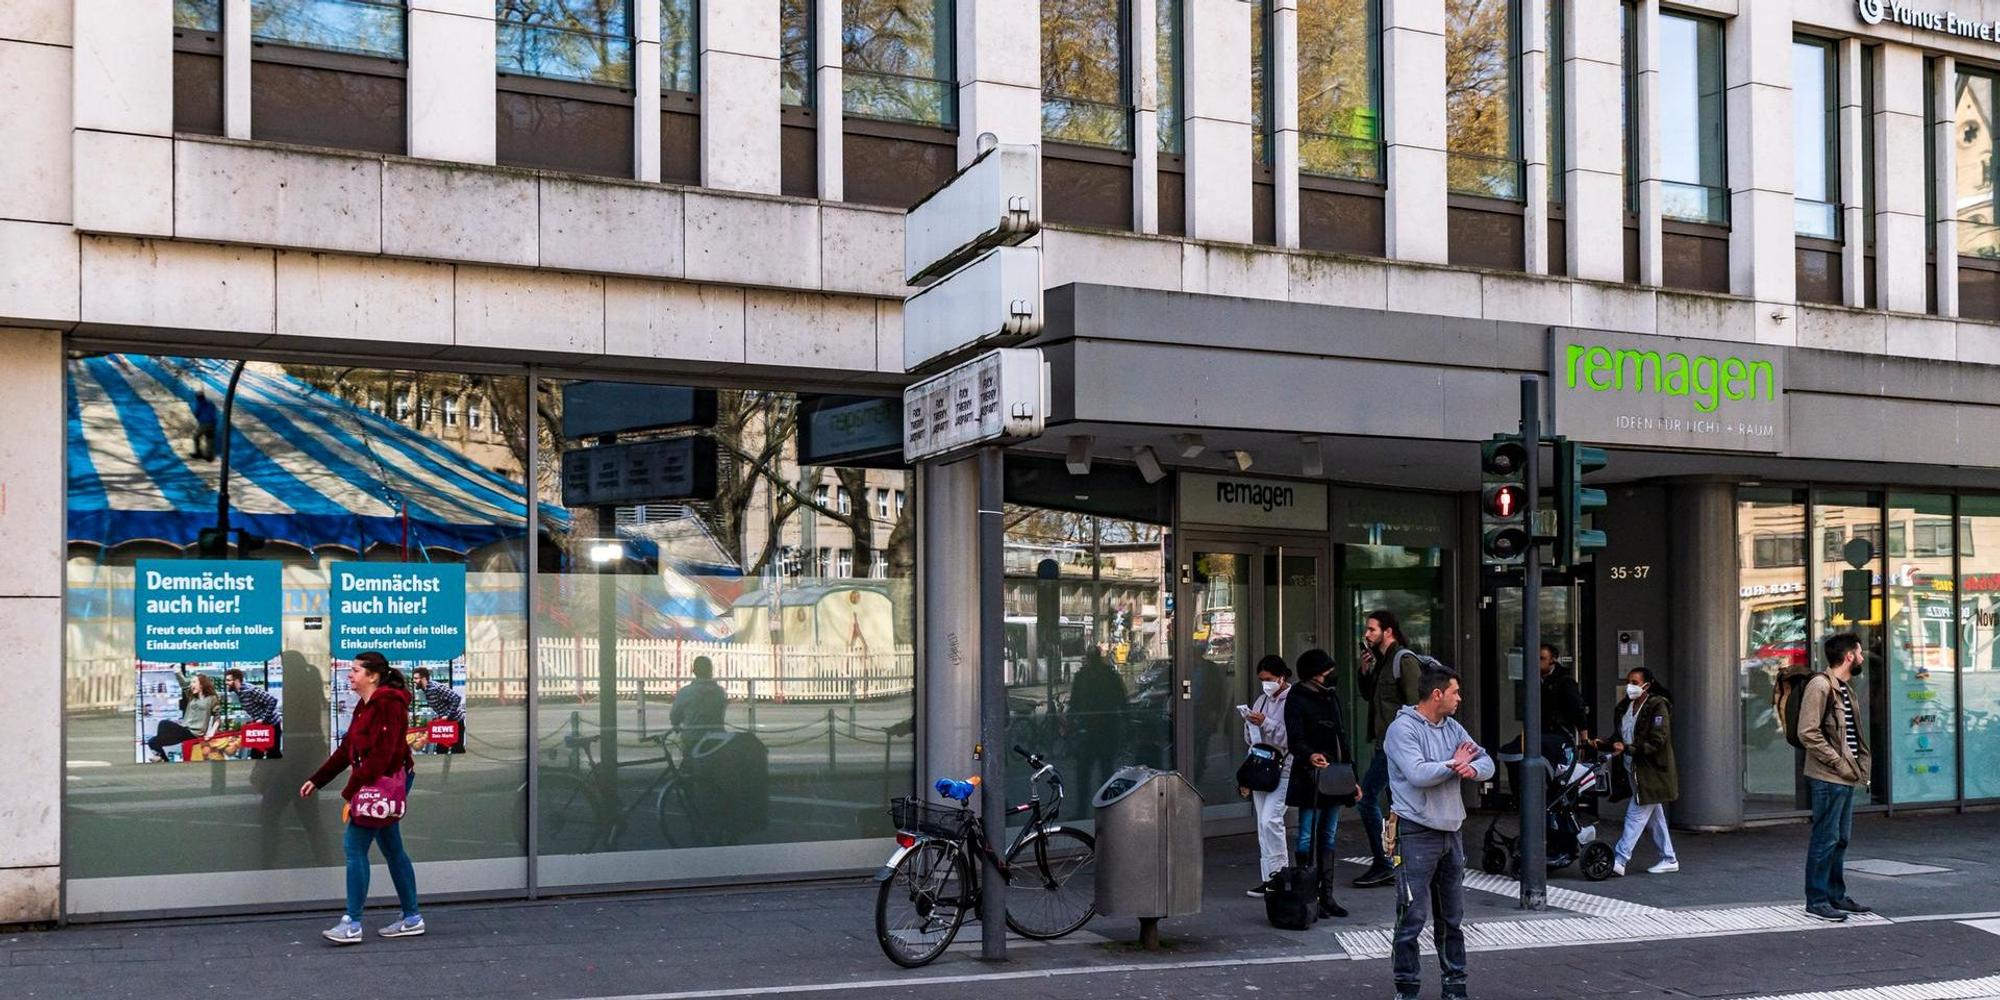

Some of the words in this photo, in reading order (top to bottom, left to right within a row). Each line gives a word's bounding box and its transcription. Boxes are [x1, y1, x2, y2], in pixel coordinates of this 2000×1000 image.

[1890, 0, 1942, 31] Yunus
[1947, 11, 1990, 41] Emre
[1566, 343, 1774, 413] remagen
[1616, 415, 1652, 430] IDEEN
[1738, 422, 1774, 436] RAUM
[1216, 482, 1294, 512] remagen
[146, 571, 254, 591] Demnächst
[341, 572, 440, 592] Demnächst
[1610, 566, 1650, 580] 35-37
[146, 595, 193, 614] auch
[197, 595, 240, 614] hier!
[341, 596, 384, 614] auch
[388, 596, 428, 614] hier!
[146, 624, 175, 635] Freut
[177, 624, 202, 635] euch
[205, 624, 223, 635] auf
[225, 624, 242, 635] ein
[244, 624, 274, 635] tolles
[341, 624, 367, 635] Freut
[369, 624, 393, 635] euch
[394, 624, 412, 635] auf
[413, 624, 428, 635] ein
[431, 624, 458, 635] tolles
[146, 640, 240, 650] Einkaufserlebnis!
[341, 639, 426, 650] Einkaufserlebnis!
[245, 729, 270, 737] REWE
[432, 725, 454, 733] REWE
